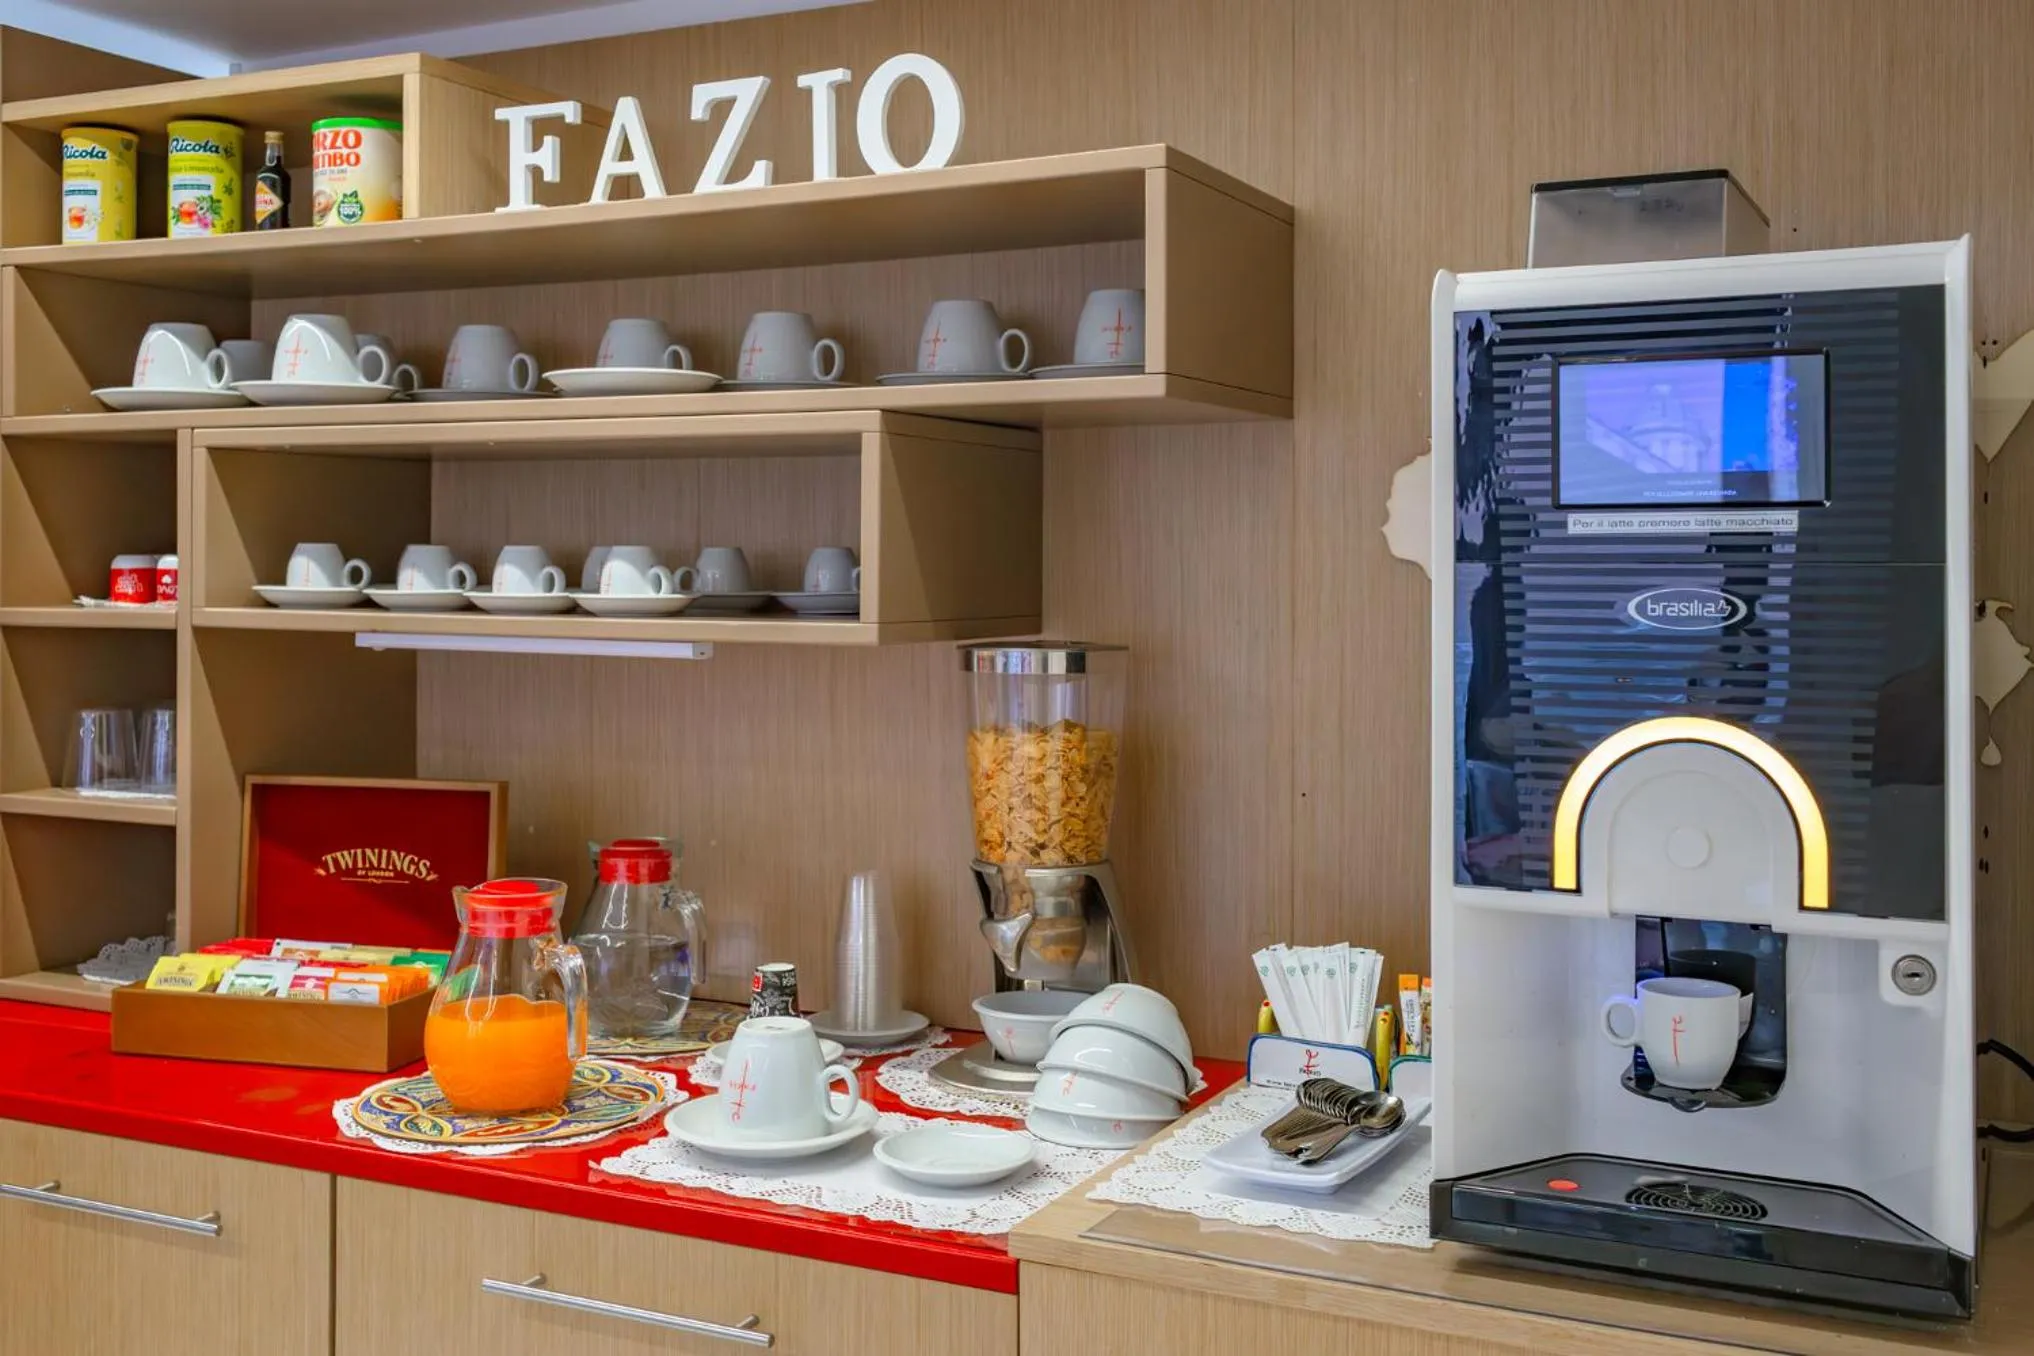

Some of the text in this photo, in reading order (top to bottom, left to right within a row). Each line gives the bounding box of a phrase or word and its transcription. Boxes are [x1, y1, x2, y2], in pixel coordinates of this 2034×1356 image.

[494, 52, 965, 214] FAZIO
[170, 137, 221, 155] Ricola
[1647, 599, 1715, 616] brasilia
[322, 848, 431, 879] TWININGS
